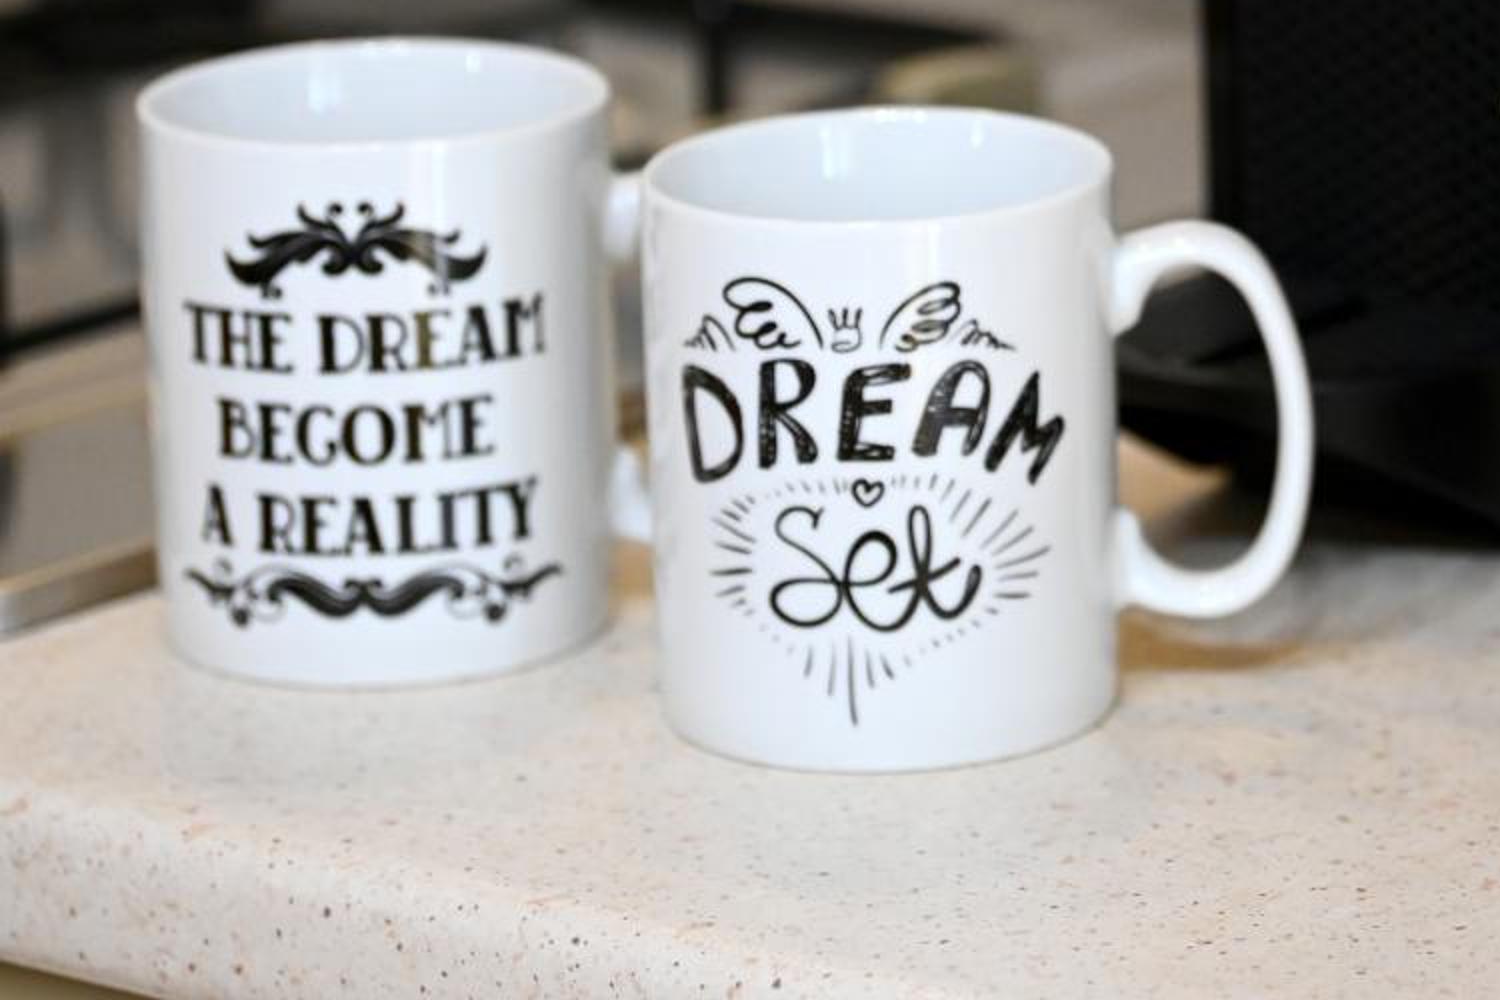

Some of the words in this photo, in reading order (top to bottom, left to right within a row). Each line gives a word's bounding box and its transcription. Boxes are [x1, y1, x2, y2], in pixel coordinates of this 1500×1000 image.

[183, 300, 294, 374] THE
[317, 292, 546, 375] DREAM
[682, 358, 1065, 485] DREAM
[202, 482, 235, 547] A
[256, 476, 538, 557] REALITY
[768, 504, 982, 632] Set
